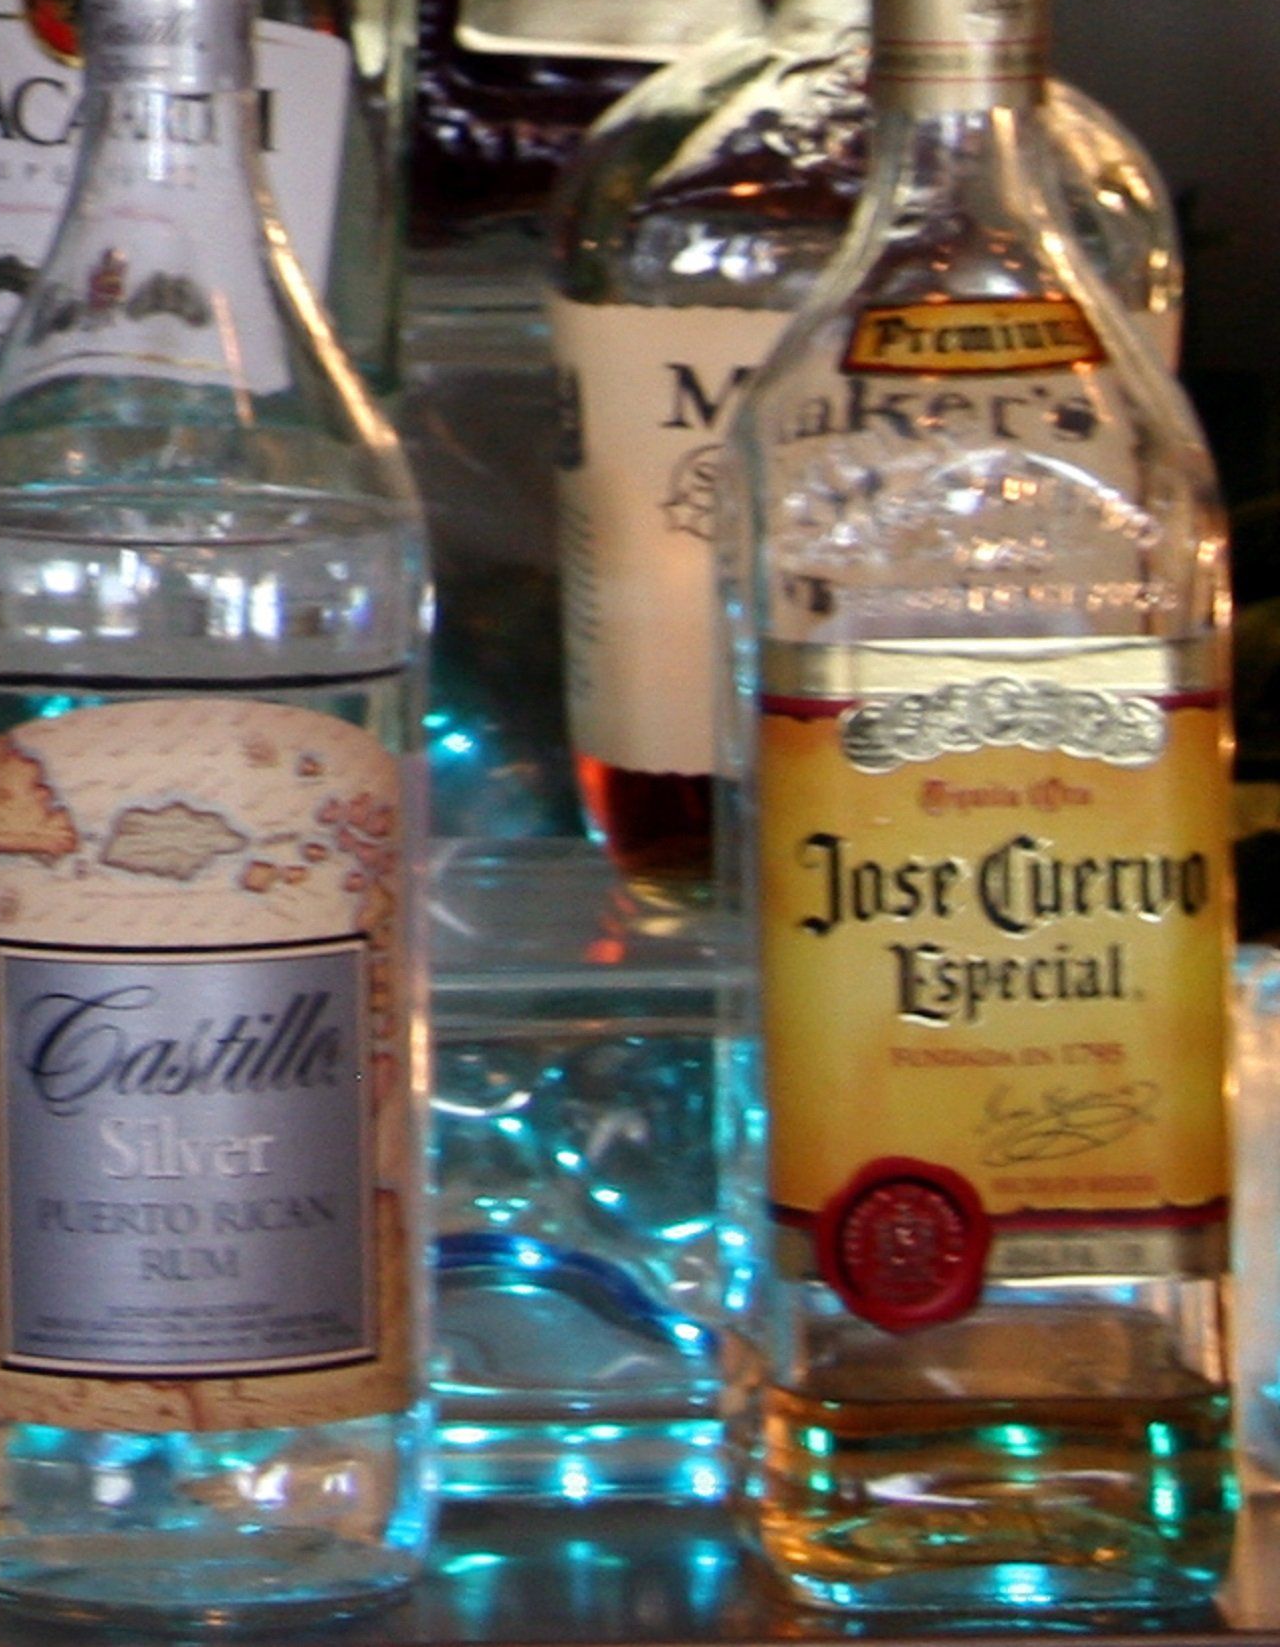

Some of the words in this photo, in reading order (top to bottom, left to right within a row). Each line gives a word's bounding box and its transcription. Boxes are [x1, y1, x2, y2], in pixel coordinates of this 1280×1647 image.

[975, 835, 1212, 935] Cuervo
[884, 944, 1136, 1028] Especial
[20, 984, 342, 1118] Castillo
[99, 1114, 278, 1181] Silver
